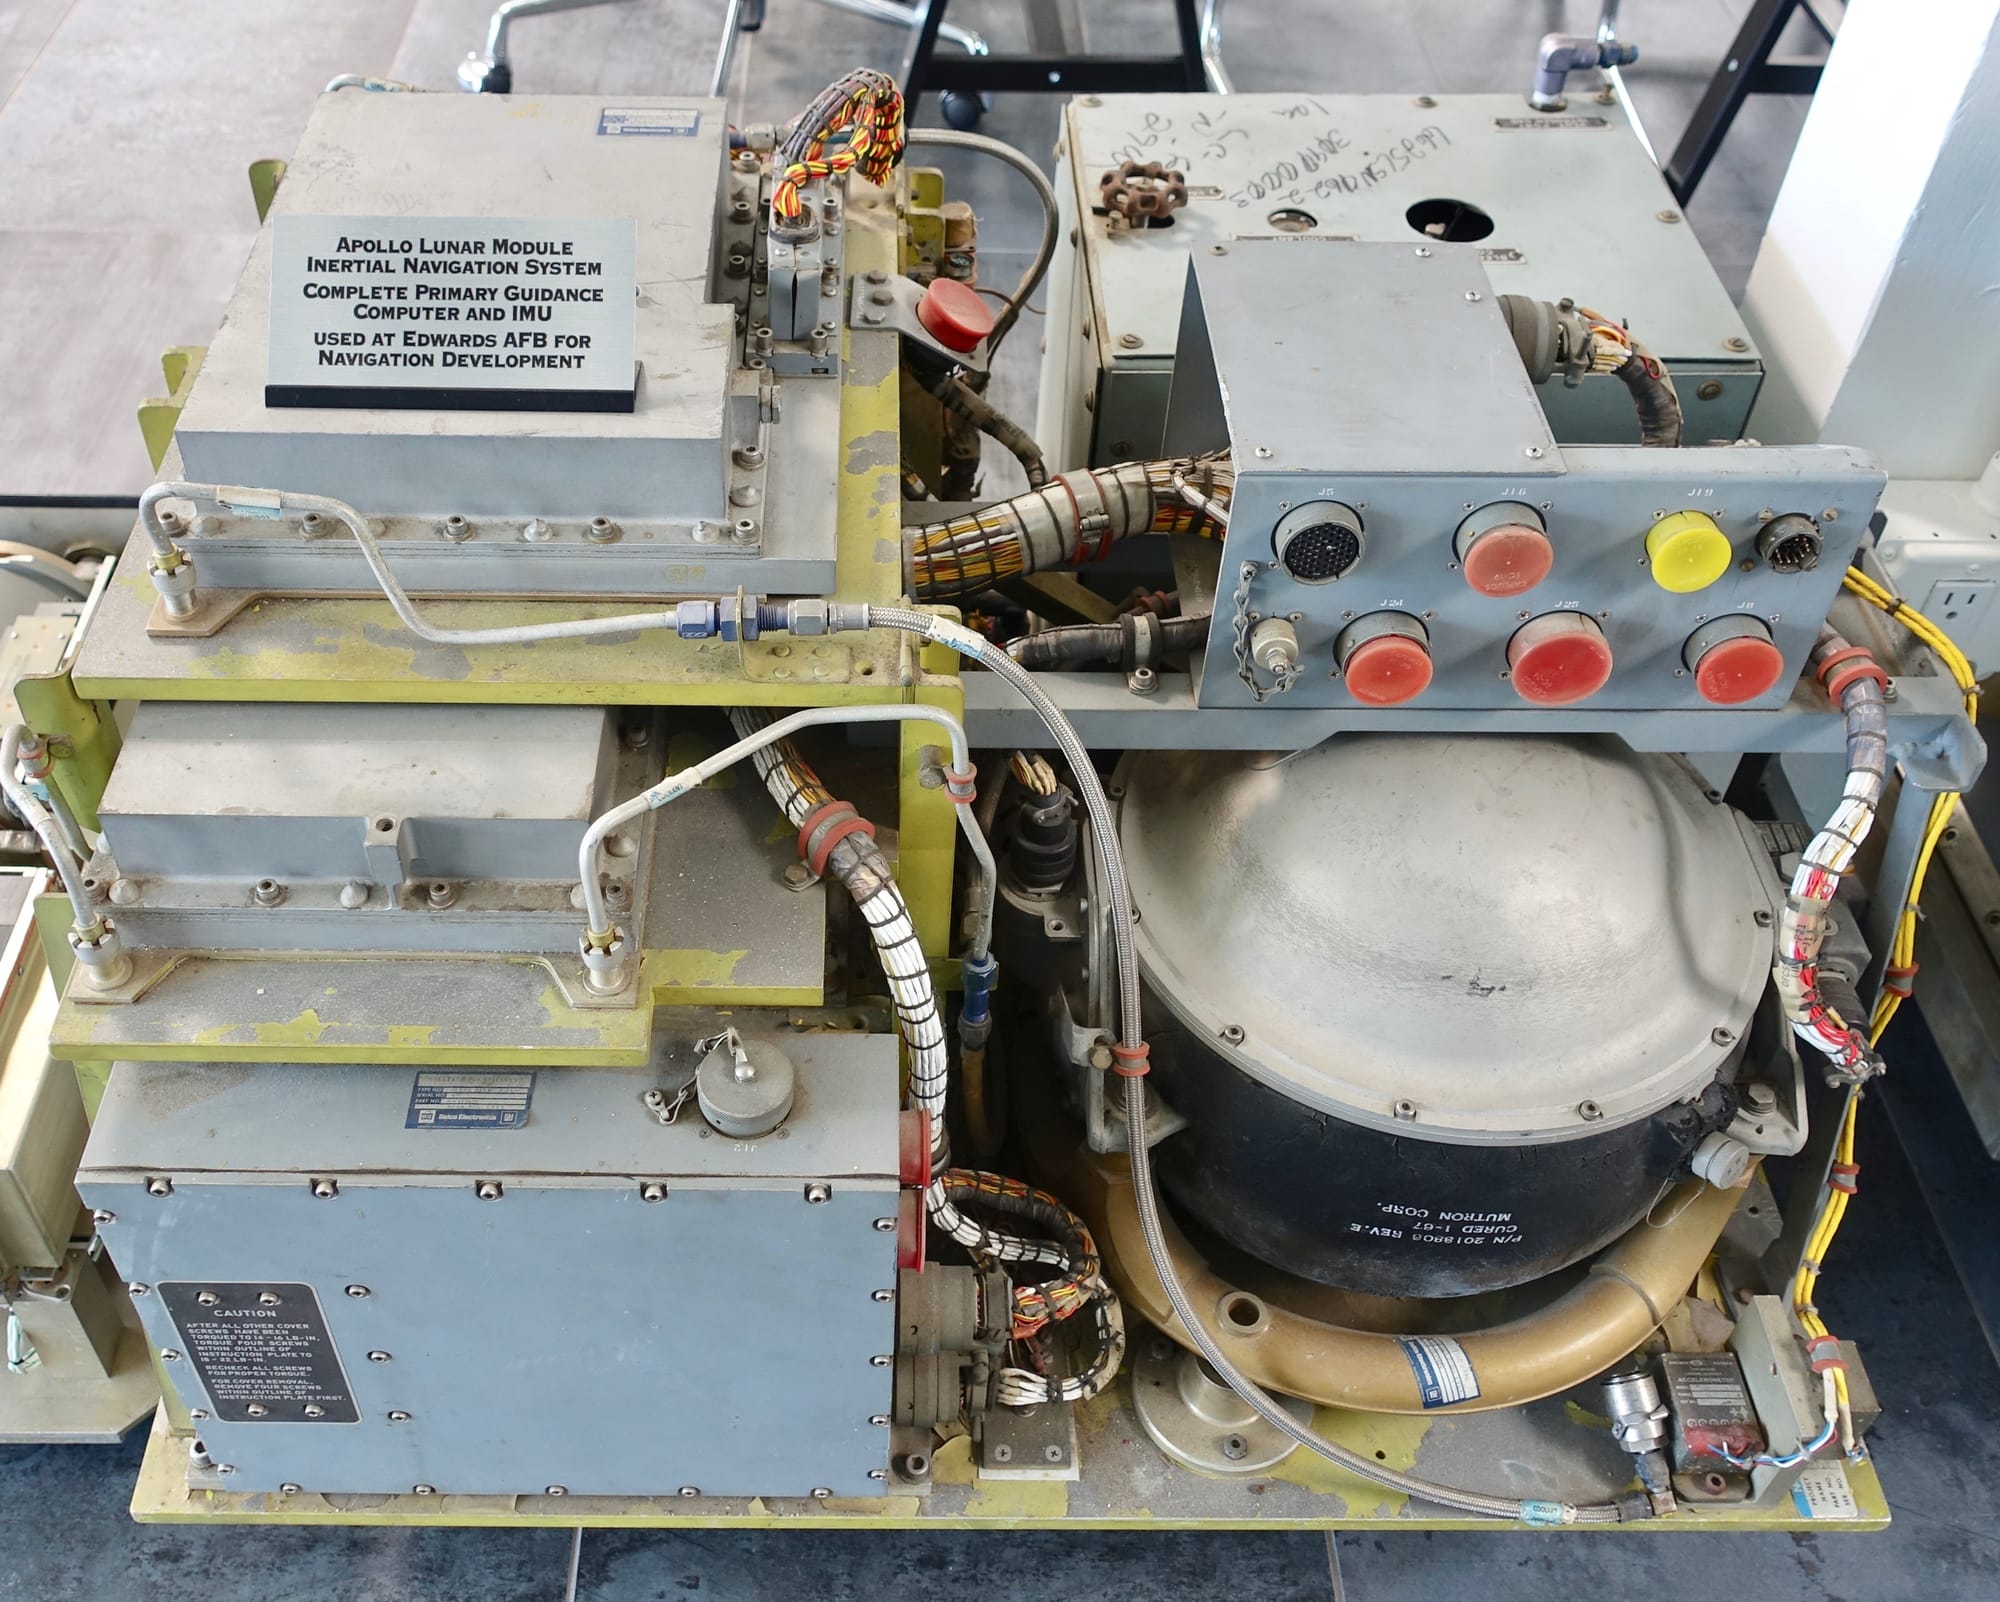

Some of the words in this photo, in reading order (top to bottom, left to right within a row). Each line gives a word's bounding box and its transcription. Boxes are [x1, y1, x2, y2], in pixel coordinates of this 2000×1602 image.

[336, 237, 412, 254] APOLLO
[419, 238, 485, 255] LUNAR
[493, 239, 573, 256] MODULE
[307, 256, 395, 273] INERTIAL
[403, 258, 519, 275] NAVIGATION
[525, 259, 602, 276] SYSTEM
[303, 283, 408, 300] COMPLETE
[415, 284, 498, 301] PRIMARY
[504, 286, 604, 303] GUIDANCE
[353, 303, 460, 321] COMPUTER
[466, 307, 505, 321] AND
[512, 306, 552, 322] IMU
[314, 332, 366, 347] USED
[372, 333, 396, 347] AT
[403, 331, 497, 348] EDWARDS
[503, 332, 548, 348] AFB
[555, 335, 592, 349] FOR
[318, 350, 434, 368] NAVIGATION
[442, 351, 585, 369] DEVELOPMENT
[1318, 488, 1335, 496] J5
[1377, 1202, 1429, 1218] CORP.
[1439, 1212, 1512, 1222] MUTRON
[1462, 1224, 1518, 1234] CURED
[1493, 1234, 1523, 1244] P/N
[213, 1309, 277, 1318] CAUTION
